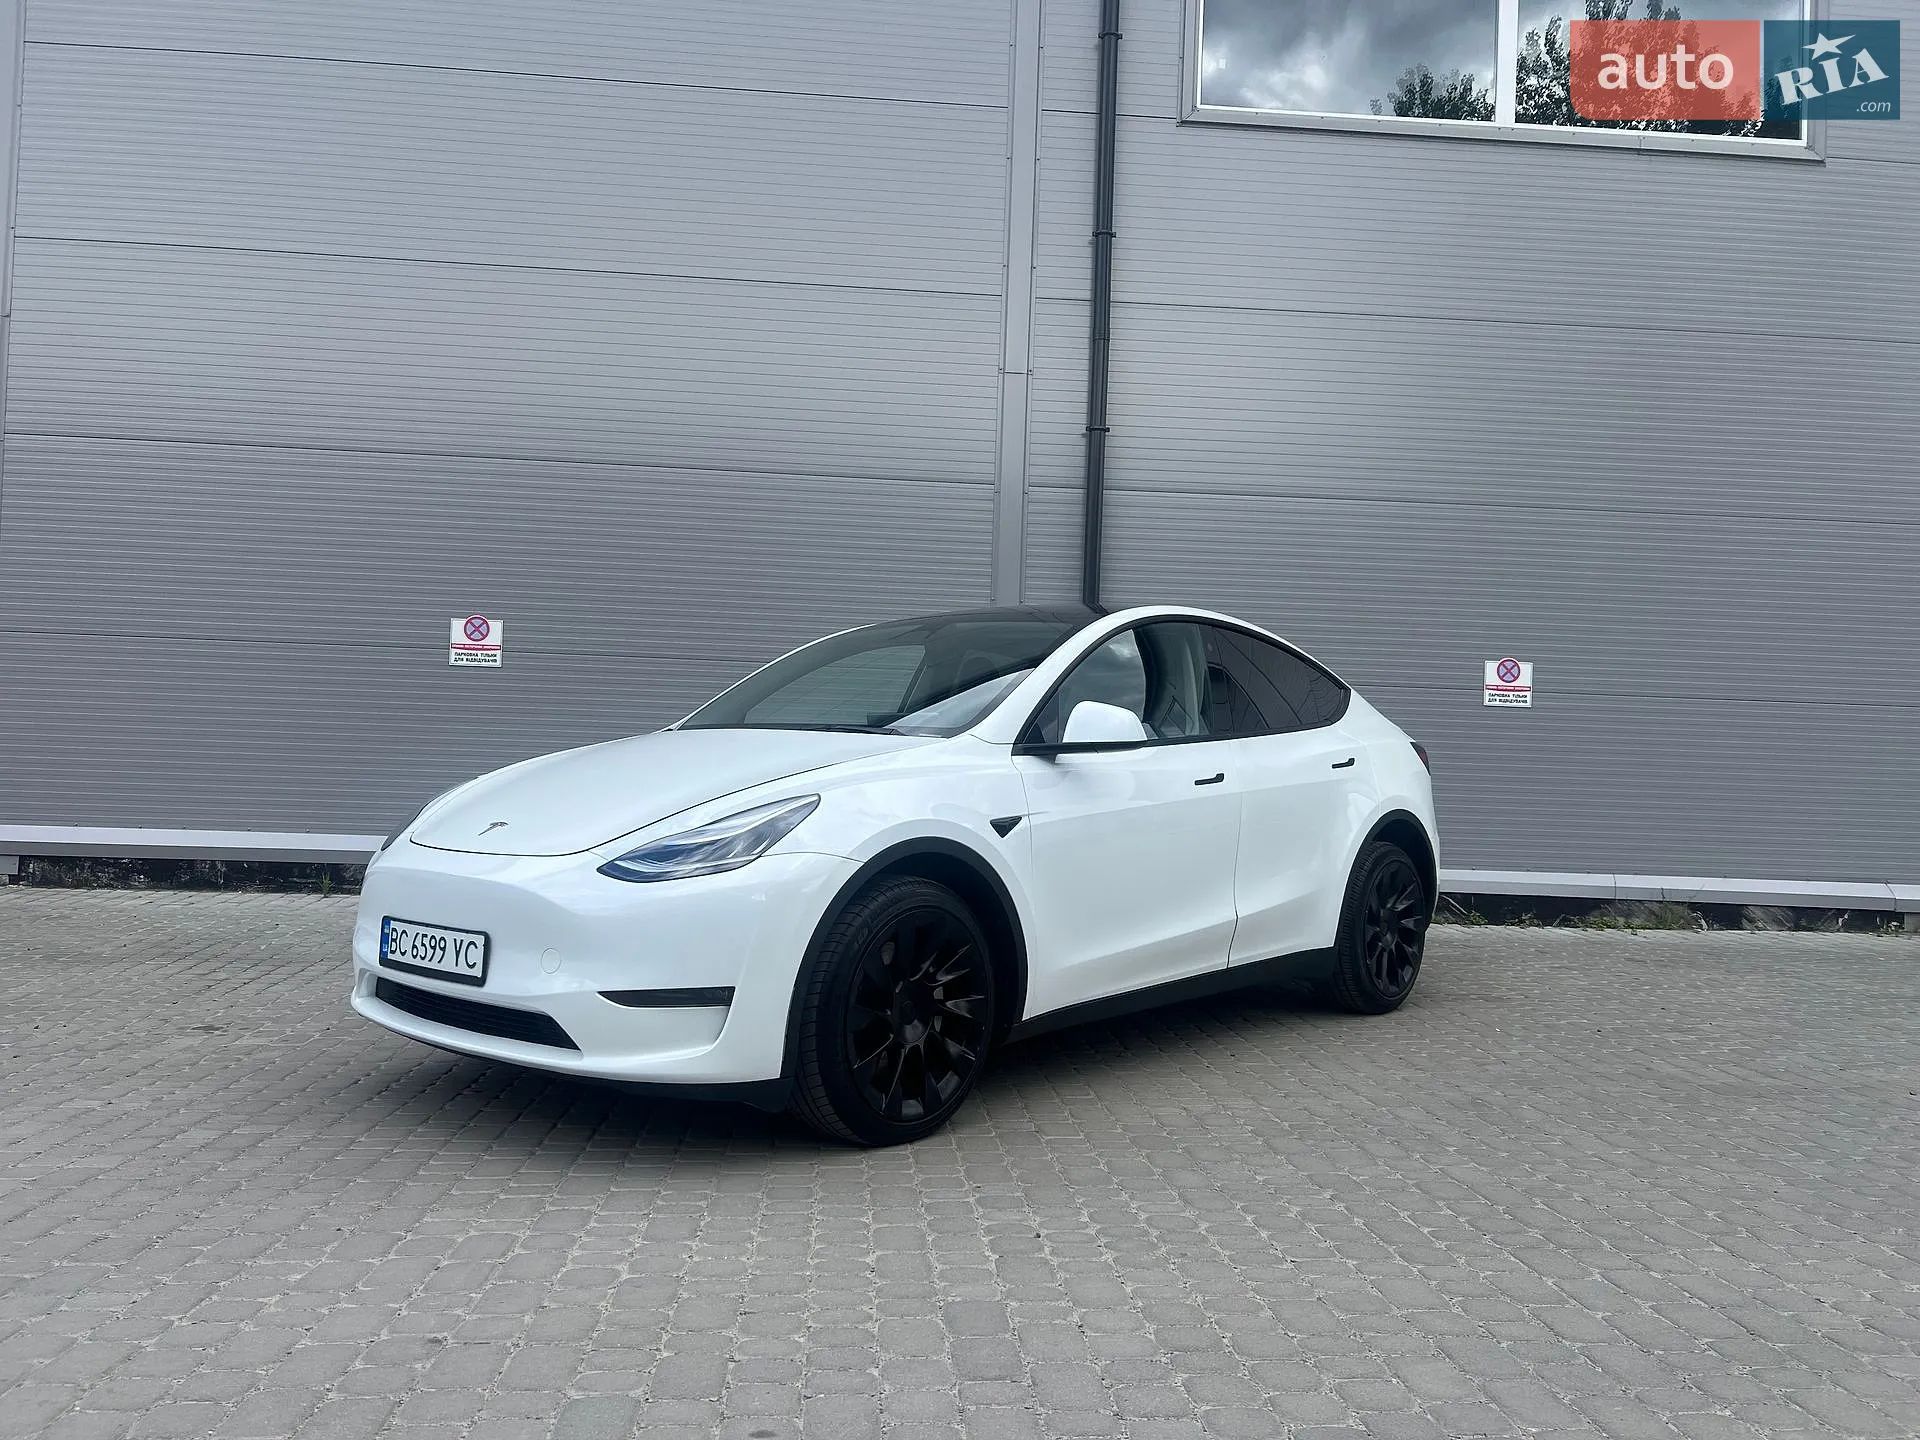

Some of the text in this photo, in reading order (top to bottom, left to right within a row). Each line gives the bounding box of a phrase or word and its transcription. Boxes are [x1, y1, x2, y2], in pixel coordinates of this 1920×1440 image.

[389, 927, 478, 969] BC 6599 YC
